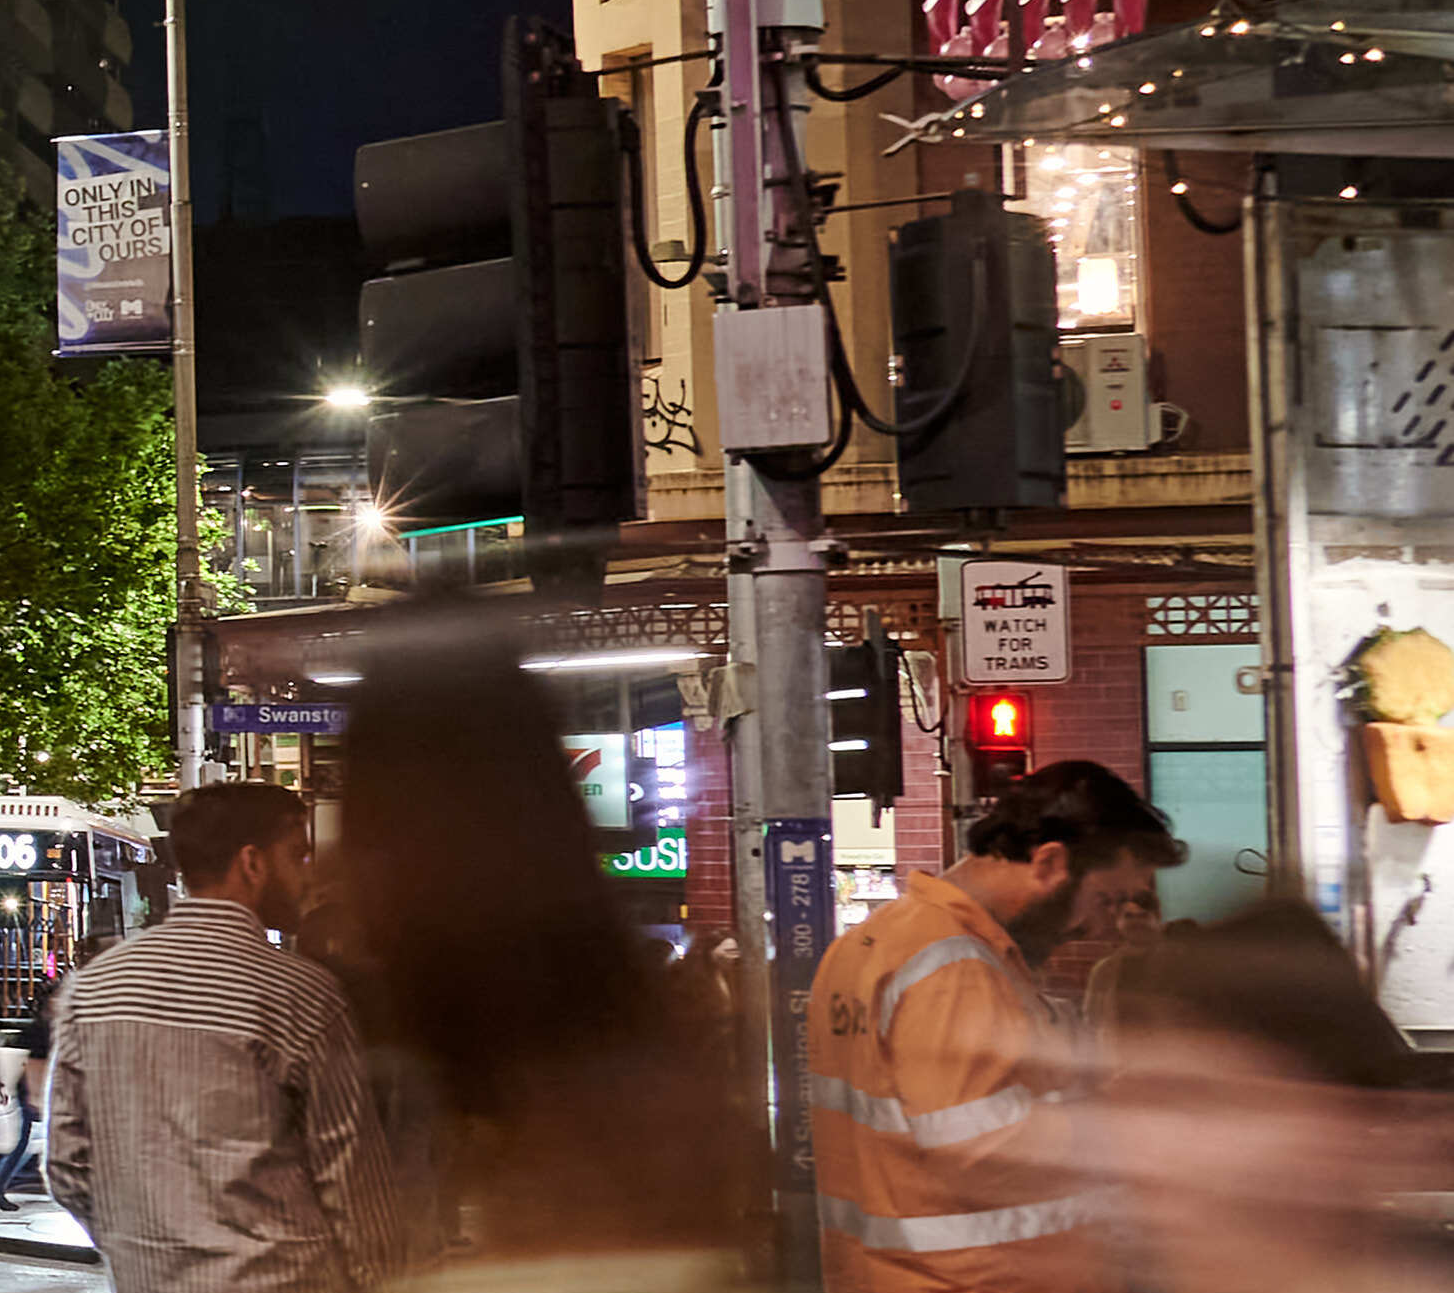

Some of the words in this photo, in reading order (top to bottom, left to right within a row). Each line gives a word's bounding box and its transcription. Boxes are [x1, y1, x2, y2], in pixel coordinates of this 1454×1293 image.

[65, 181, 123, 207] ONLY
[130, 177, 152, 197] IN
[82, 200, 136, 223] THIS
[72, 221, 124, 246] CITY
[130, 216, 161, 238] OF
[99, 237, 162, 262] OURS
[983, 618, 1047, 633] WATCH
[998, 637, 1032, 652] FOR
[983, 656, 1050, 671] TRAMS
[258, 706, 346, 724] Swansto
[791, 872, 813, 907] 278
[793, 922, 813, 959] 300
